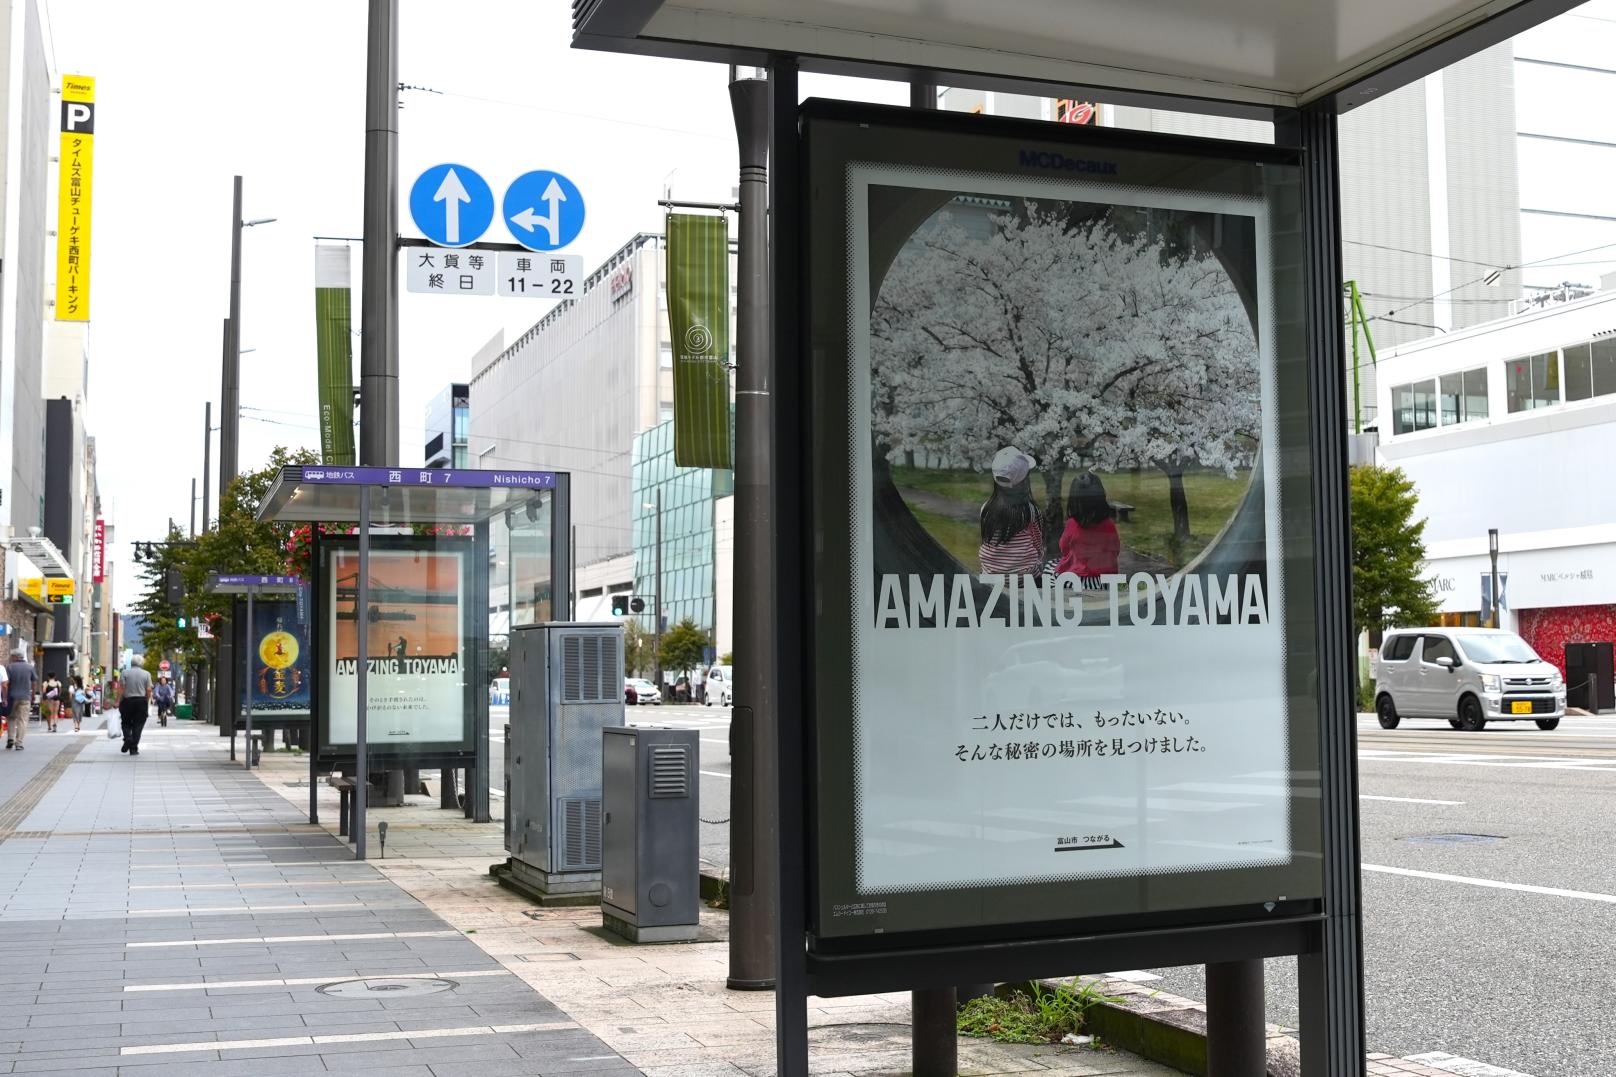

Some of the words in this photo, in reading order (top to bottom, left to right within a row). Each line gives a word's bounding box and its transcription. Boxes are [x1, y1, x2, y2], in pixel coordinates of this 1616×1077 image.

[66, 82, 91, 91] Times
[67, 103, 91, 131] P
[1019, 149, 1118, 175] MCDecaux
[419, 253, 484, 271] 大貨等
[516, 258, 566, 274] 車両
[428, 274, 474, 290] 終日
[325, 471, 355, 479] 地鉄バス
[389, 470, 433, 484] 西町
[444, 473, 452, 483] 7
[494, 474, 541, 485] Nishicho
[544, 476, 551, 485] 7
[875, 571, 1083, 629] AMAZING
[1103, 571, 1268, 627] TOYAMA
[336, 659, 399, 675] AMZING
[404, 658, 458, 675] TOYAMA
[954, 736, 1206, 761] そんな秘密の場所を見つけました。
[1057, 836, 1078, 845] 富山市
[1083, 834, 1110, 843] つながる
